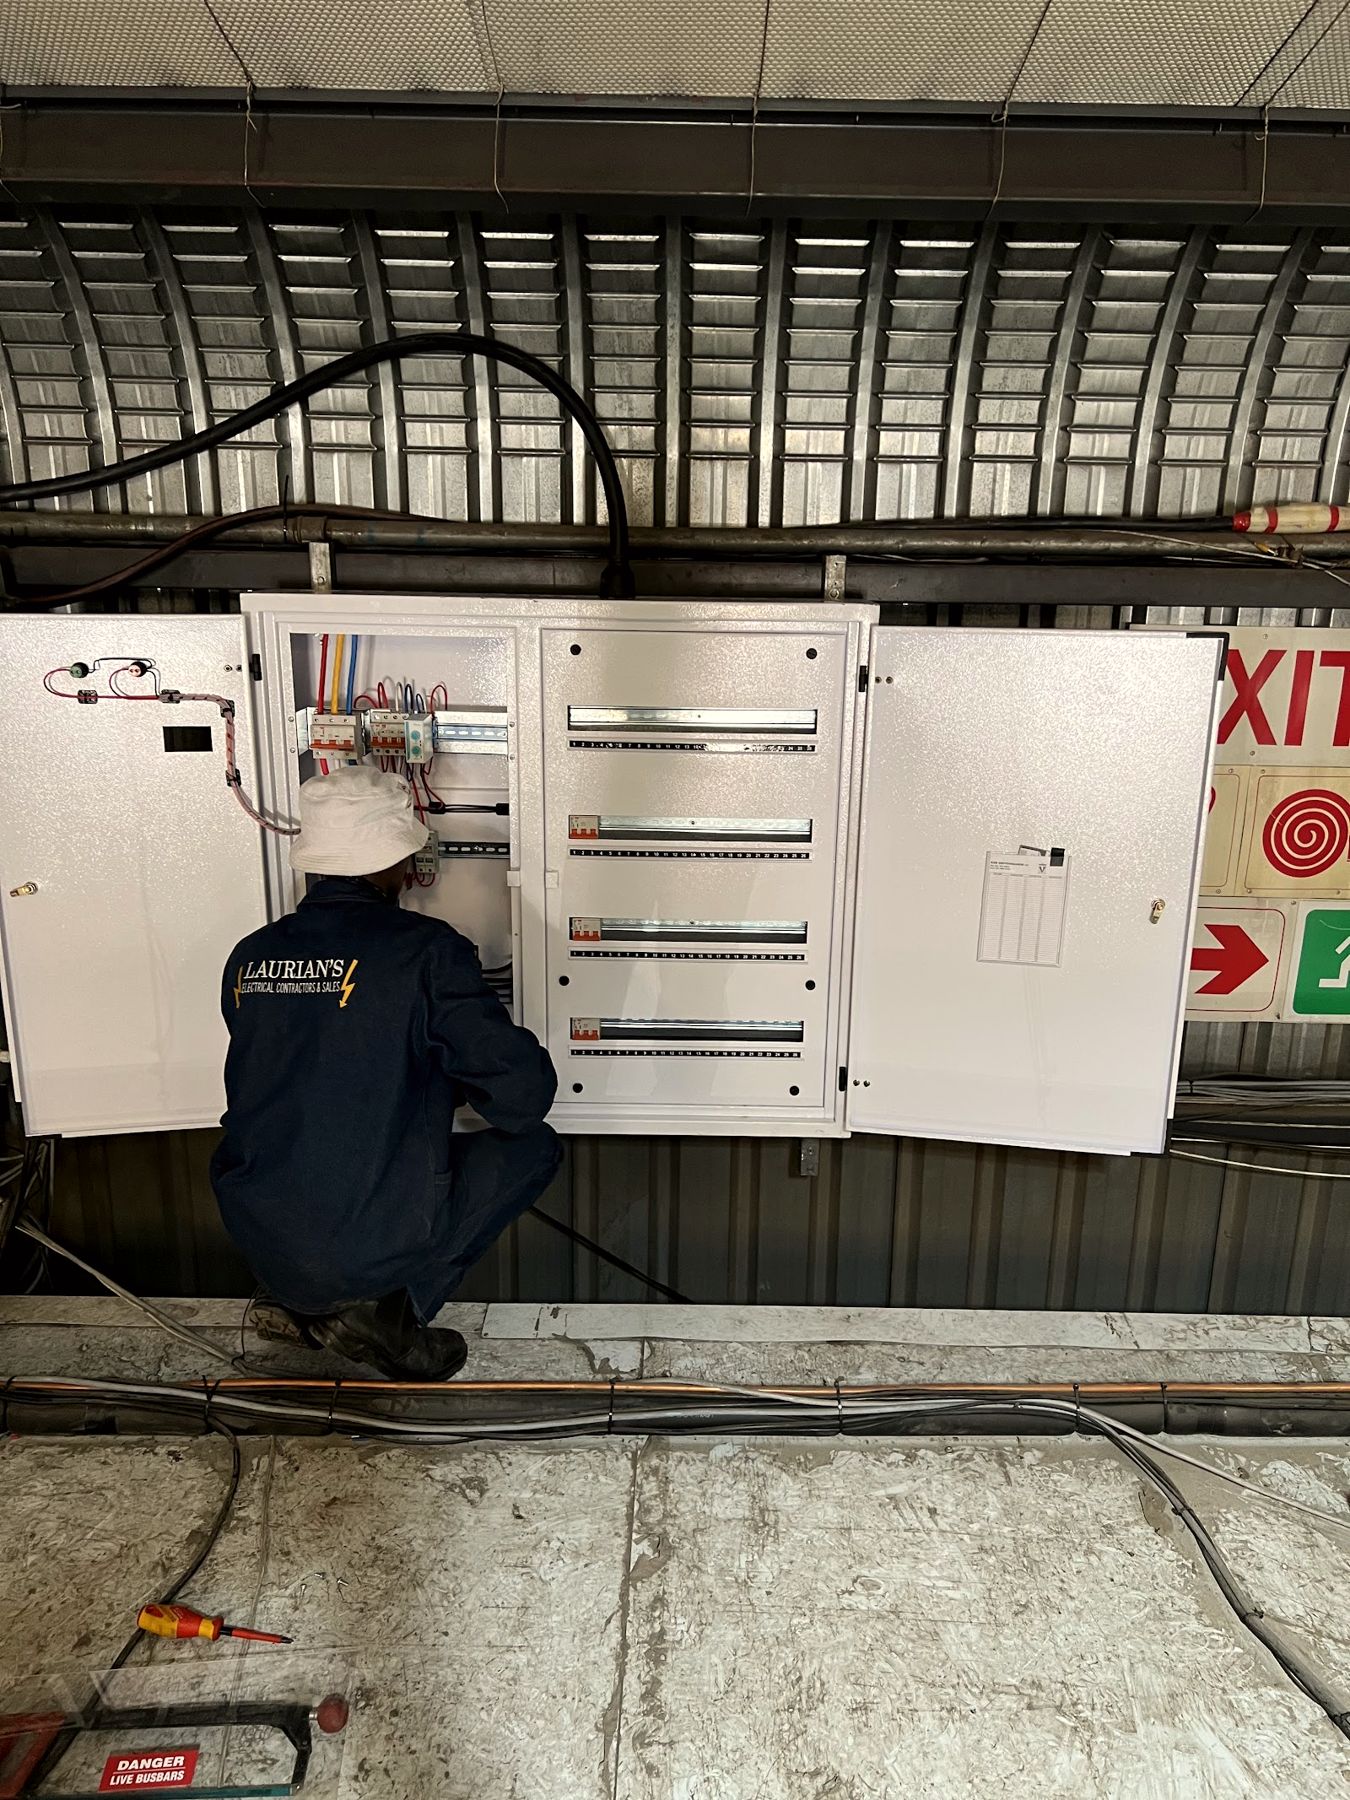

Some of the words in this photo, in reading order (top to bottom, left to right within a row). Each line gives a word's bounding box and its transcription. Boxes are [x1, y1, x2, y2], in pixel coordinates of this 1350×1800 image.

[1216, 649, 1350, 747] XIT
[244, 959, 344, 979] LAURIAN'S
[241, 982, 274, 993] ELECTRICAL
[276, 981, 316, 993] CONTRACTORS
[322, 981, 340, 993] SALES
[117, 1756, 185, 1771] DANGER
[109, 1774, 133, 1786] LIVE
[135, 1770, 184, 1784] BUSBARS
